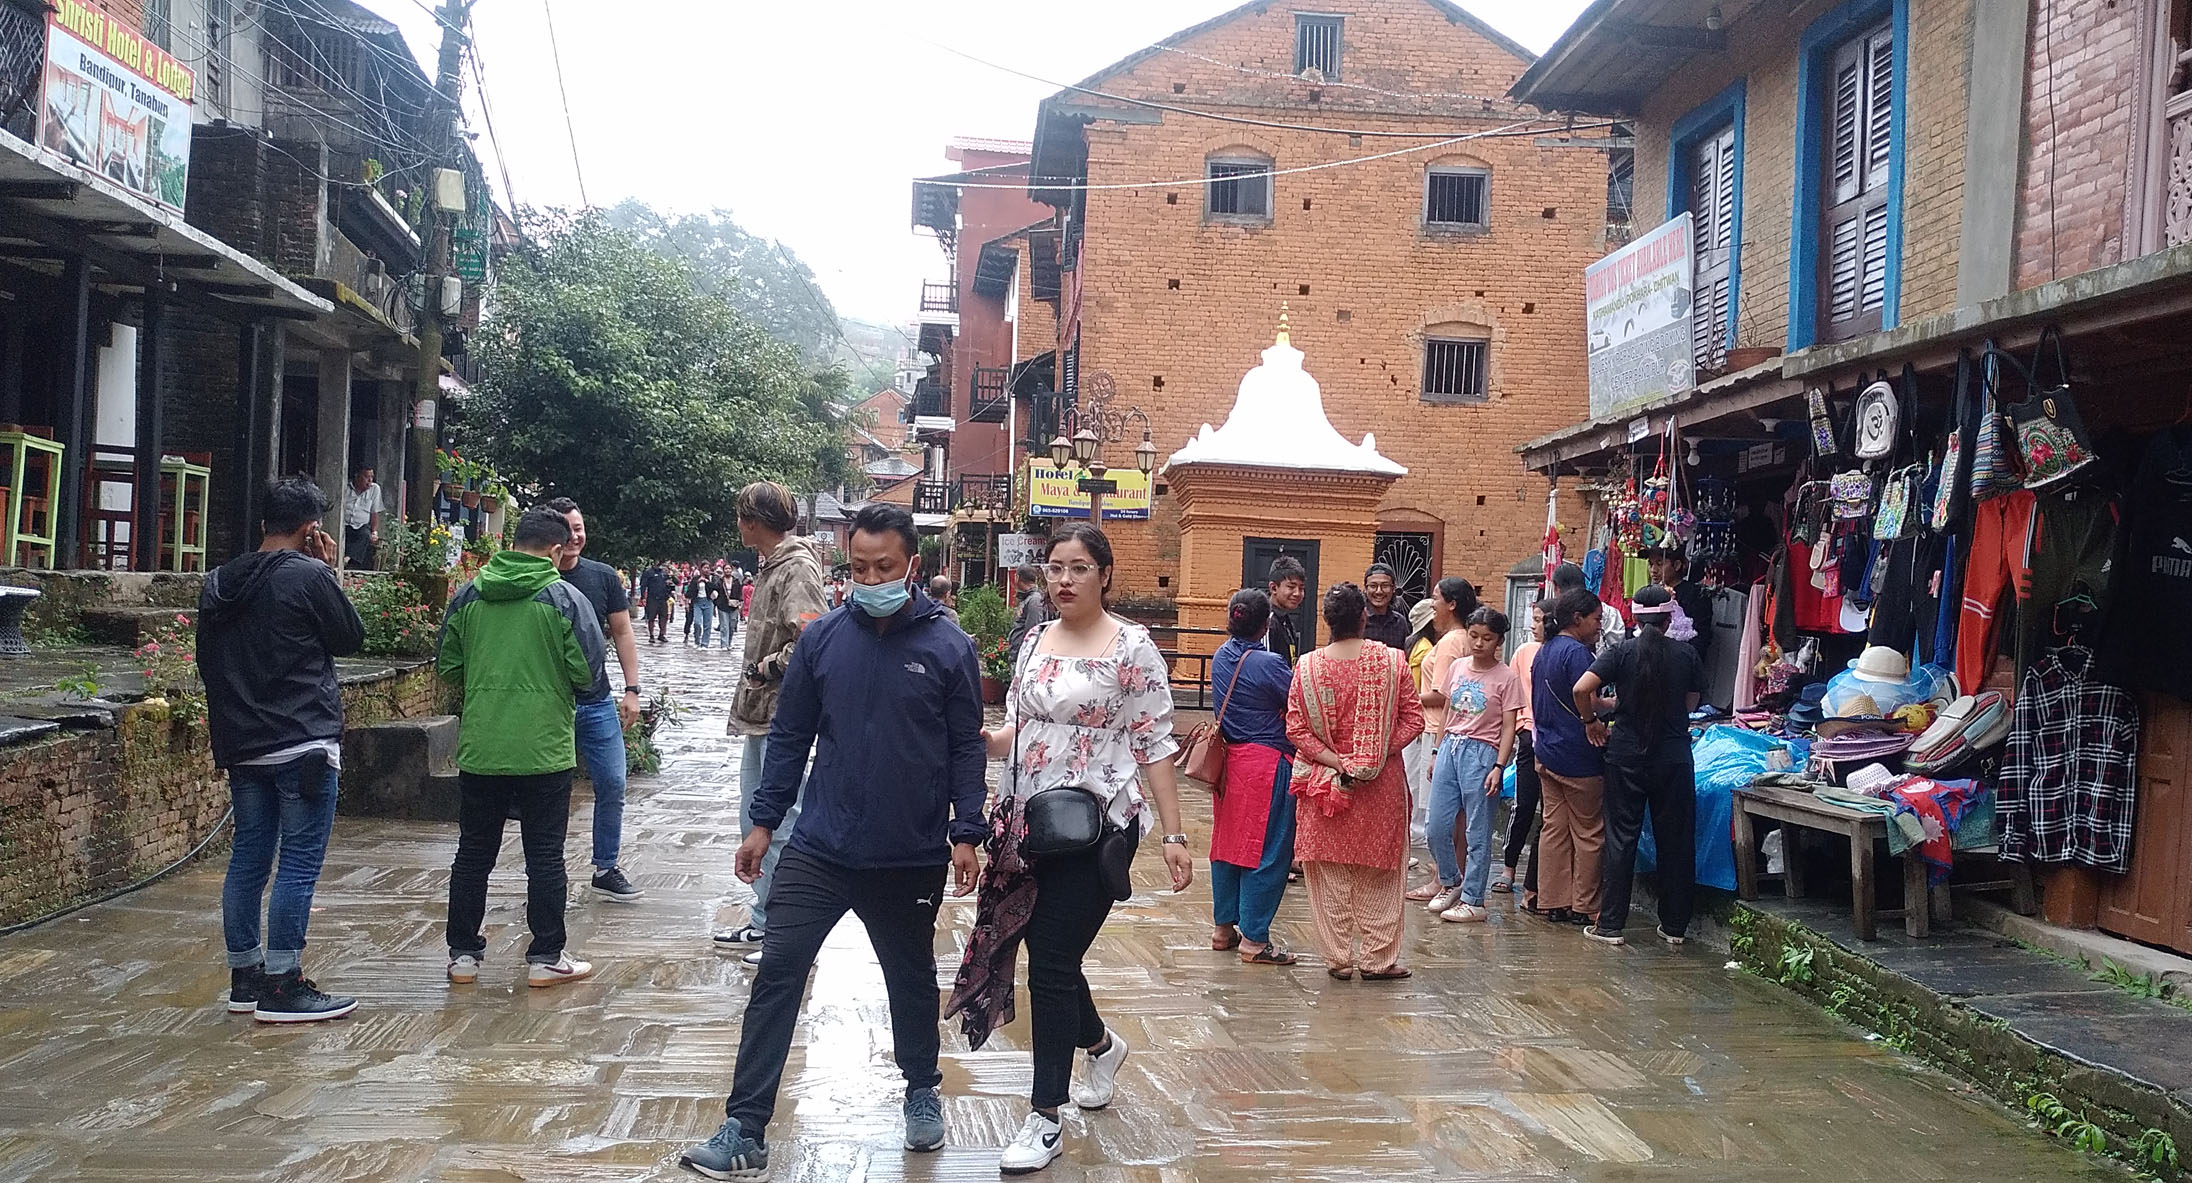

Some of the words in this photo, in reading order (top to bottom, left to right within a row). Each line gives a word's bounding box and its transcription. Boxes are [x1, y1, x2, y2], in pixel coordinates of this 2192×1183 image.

[107, 18, 143, 72] Hotel
[144, 49, 155, 80] &
[157, 49, 192, 101] Lodge
[79, 53, 128, 98] Bandipur,
[130, 82, 169, 119] Tanahun
[1034, 468, 1073, 480] Hotel
[1040, 482, 1070, 500] Maya
[1001, 536, 1015, 546] Ice
